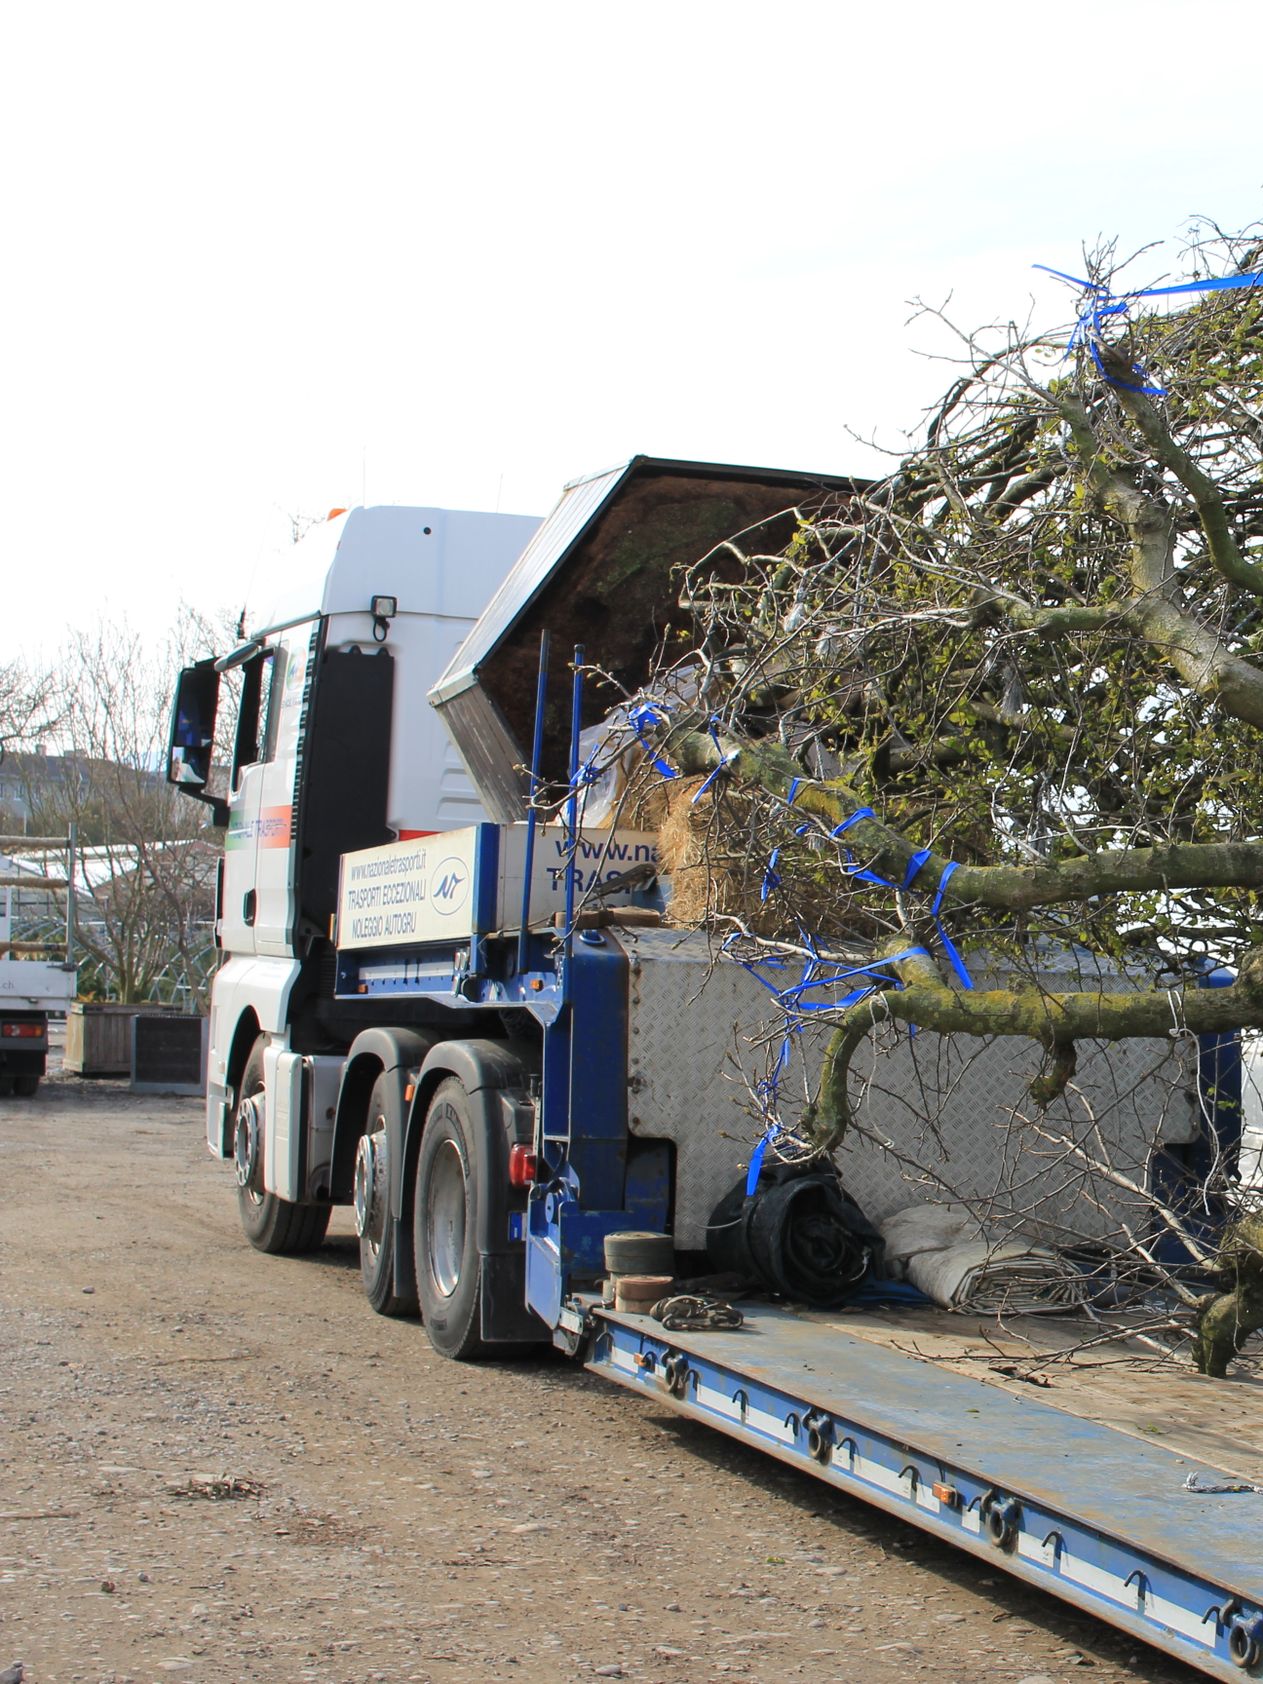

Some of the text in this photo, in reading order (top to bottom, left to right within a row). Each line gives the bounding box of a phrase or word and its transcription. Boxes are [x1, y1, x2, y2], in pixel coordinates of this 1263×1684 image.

[348, 879, 427, 910] TRASPORTI ECCEZIONALI
[351, 911, 417, 939] NOLEGGIO AUTOGRU
